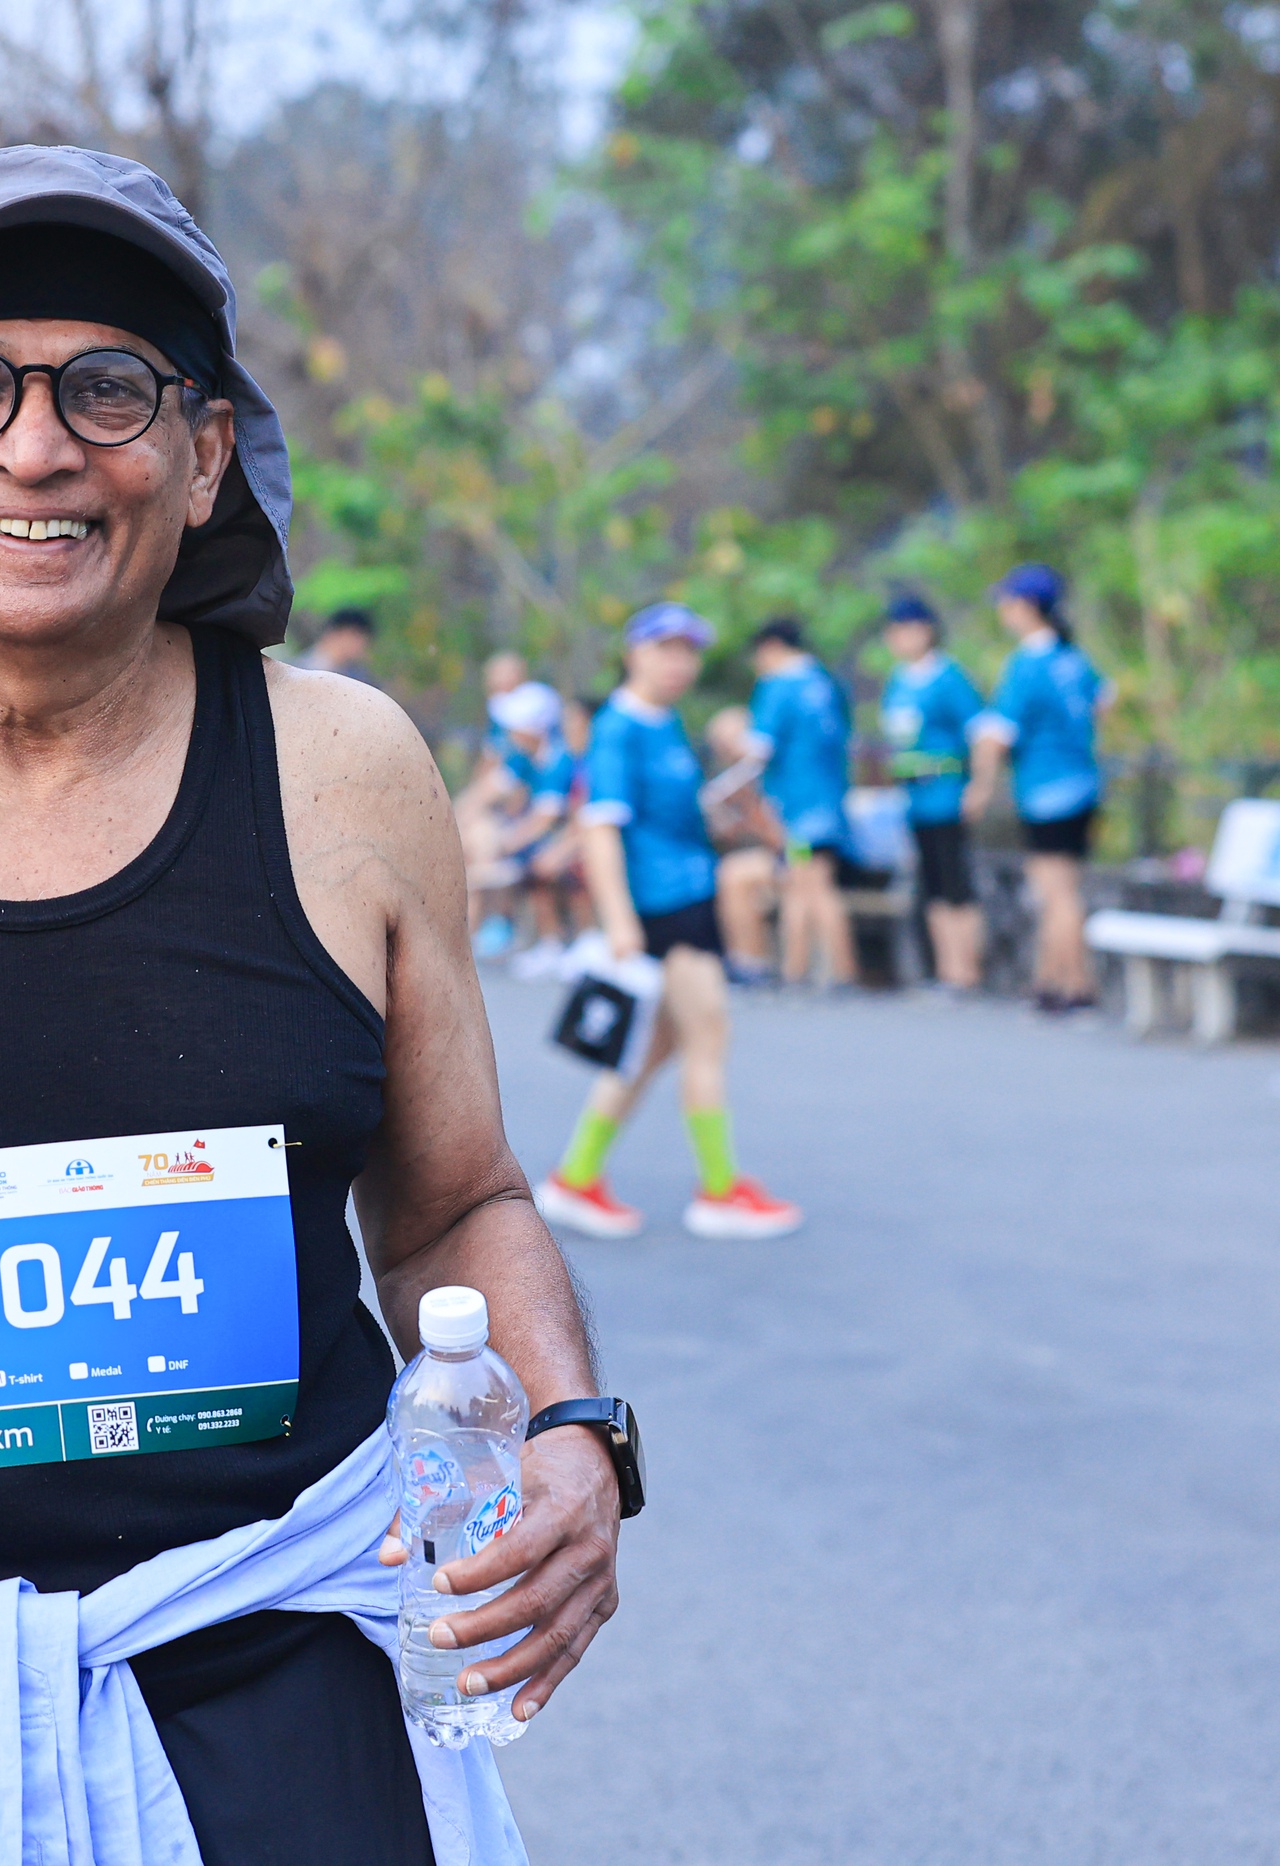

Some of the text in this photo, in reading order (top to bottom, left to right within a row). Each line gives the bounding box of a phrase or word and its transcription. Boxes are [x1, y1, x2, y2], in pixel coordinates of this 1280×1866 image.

[138, 1152, 169, 1171] 70
[91, 1365, 122, 1378] Medal
[168, 1359, 189, 1371] DNF
[8, 1373, 43, 1386] T-shirt
[197, 1407, 243, 1420] 090.863.2868
[155, 1426, 162, 1434] Y
[198, 1418, 240, 1431] 091.332.2233
